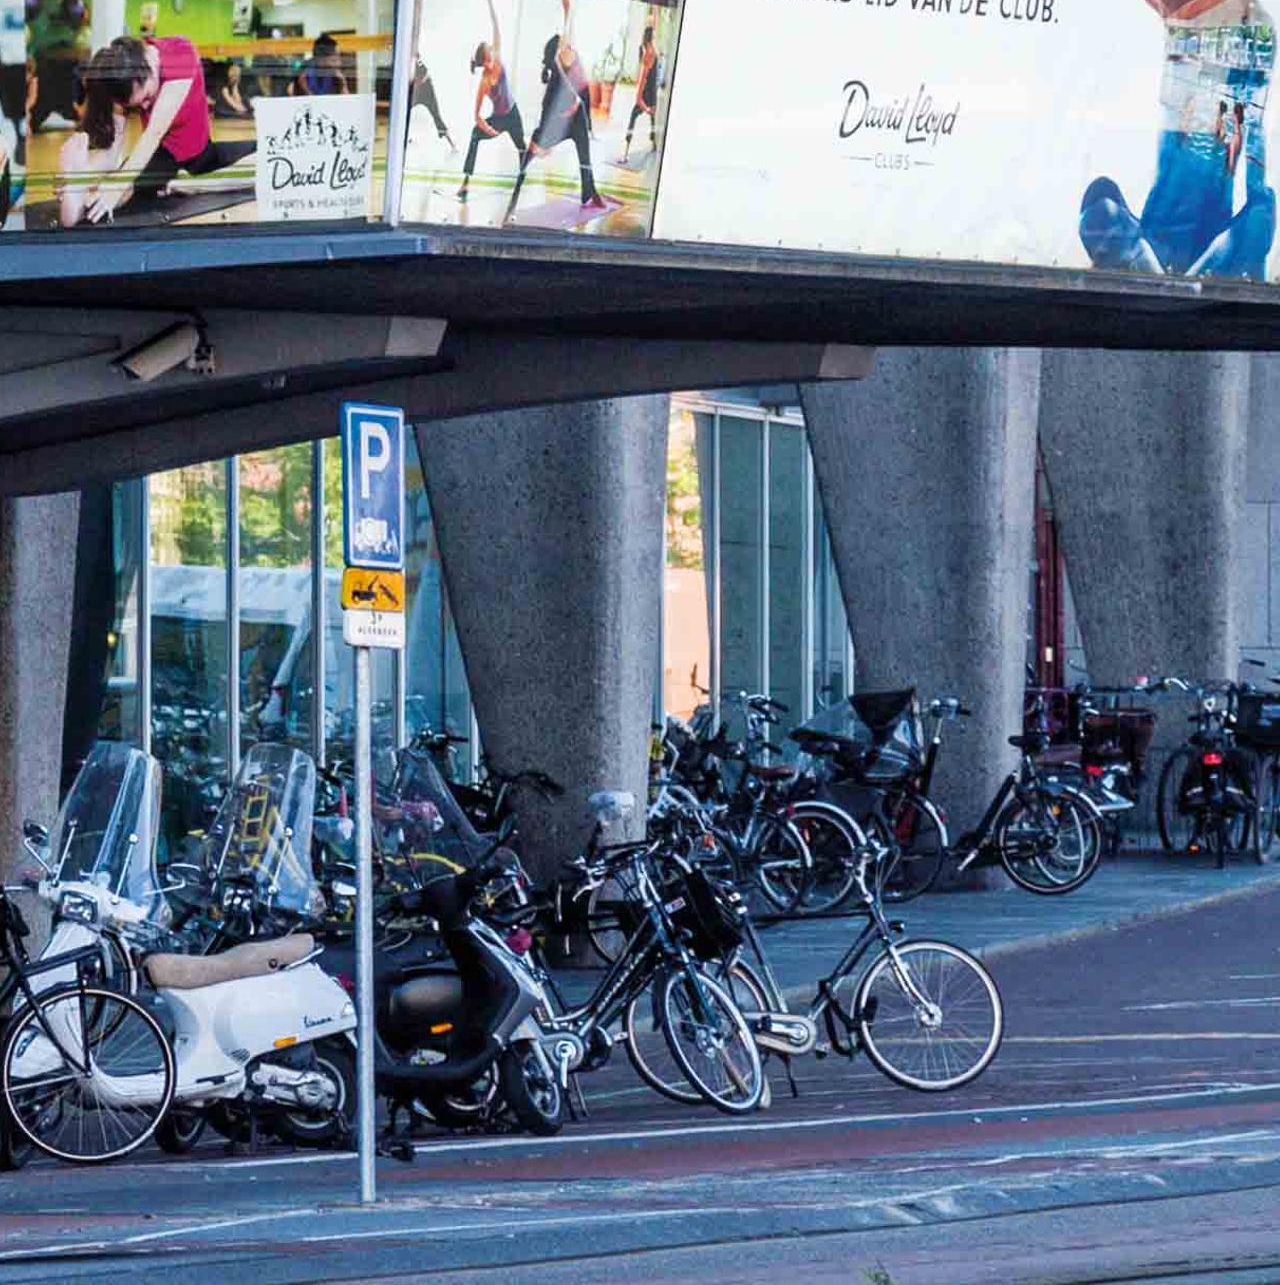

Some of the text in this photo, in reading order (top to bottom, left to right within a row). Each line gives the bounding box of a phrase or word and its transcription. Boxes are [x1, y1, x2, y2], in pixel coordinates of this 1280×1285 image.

[838, 79, 961, 147] David Lloyd
[266, 156, 326, 191] David
[358, 420, 391, 500] P
